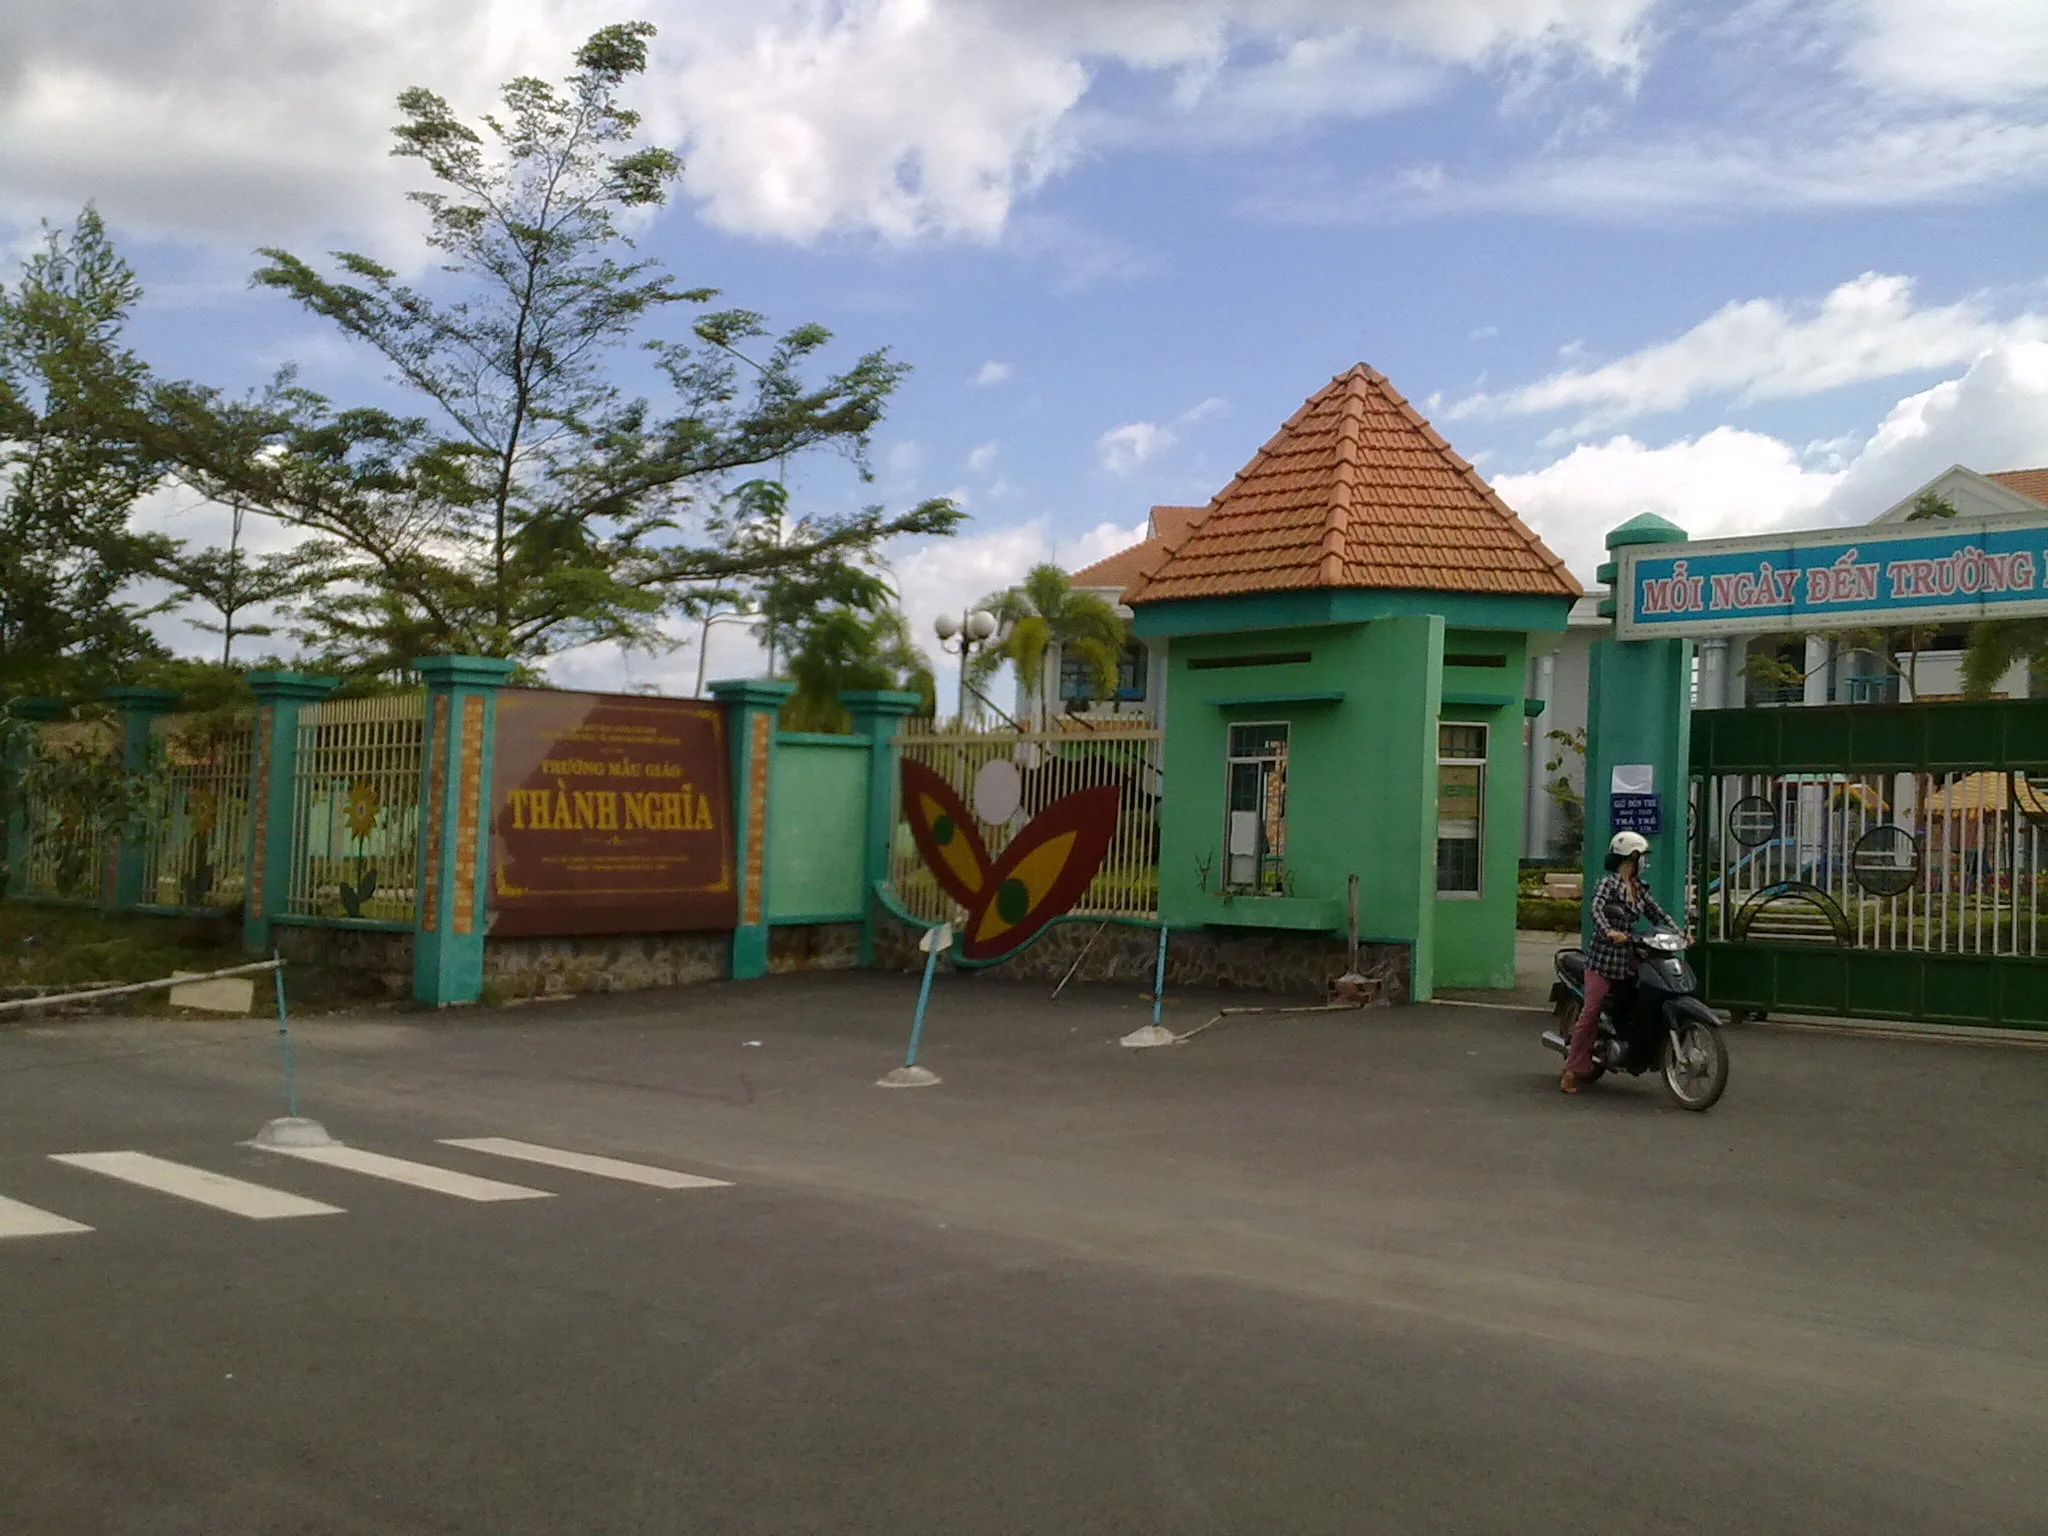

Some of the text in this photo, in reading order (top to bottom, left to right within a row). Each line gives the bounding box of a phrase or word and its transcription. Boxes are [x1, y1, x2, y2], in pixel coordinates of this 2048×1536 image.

[1642, 560, 1703, 614] MỖI
[1709, 562, 1800, 610] NGÀY
[1806, 548, 1880, 604] ĐẾN
[1886, 545, 2036, 598] TRƯỜNG
[507, 778, 714, 830] THÀNH NGHĨA
